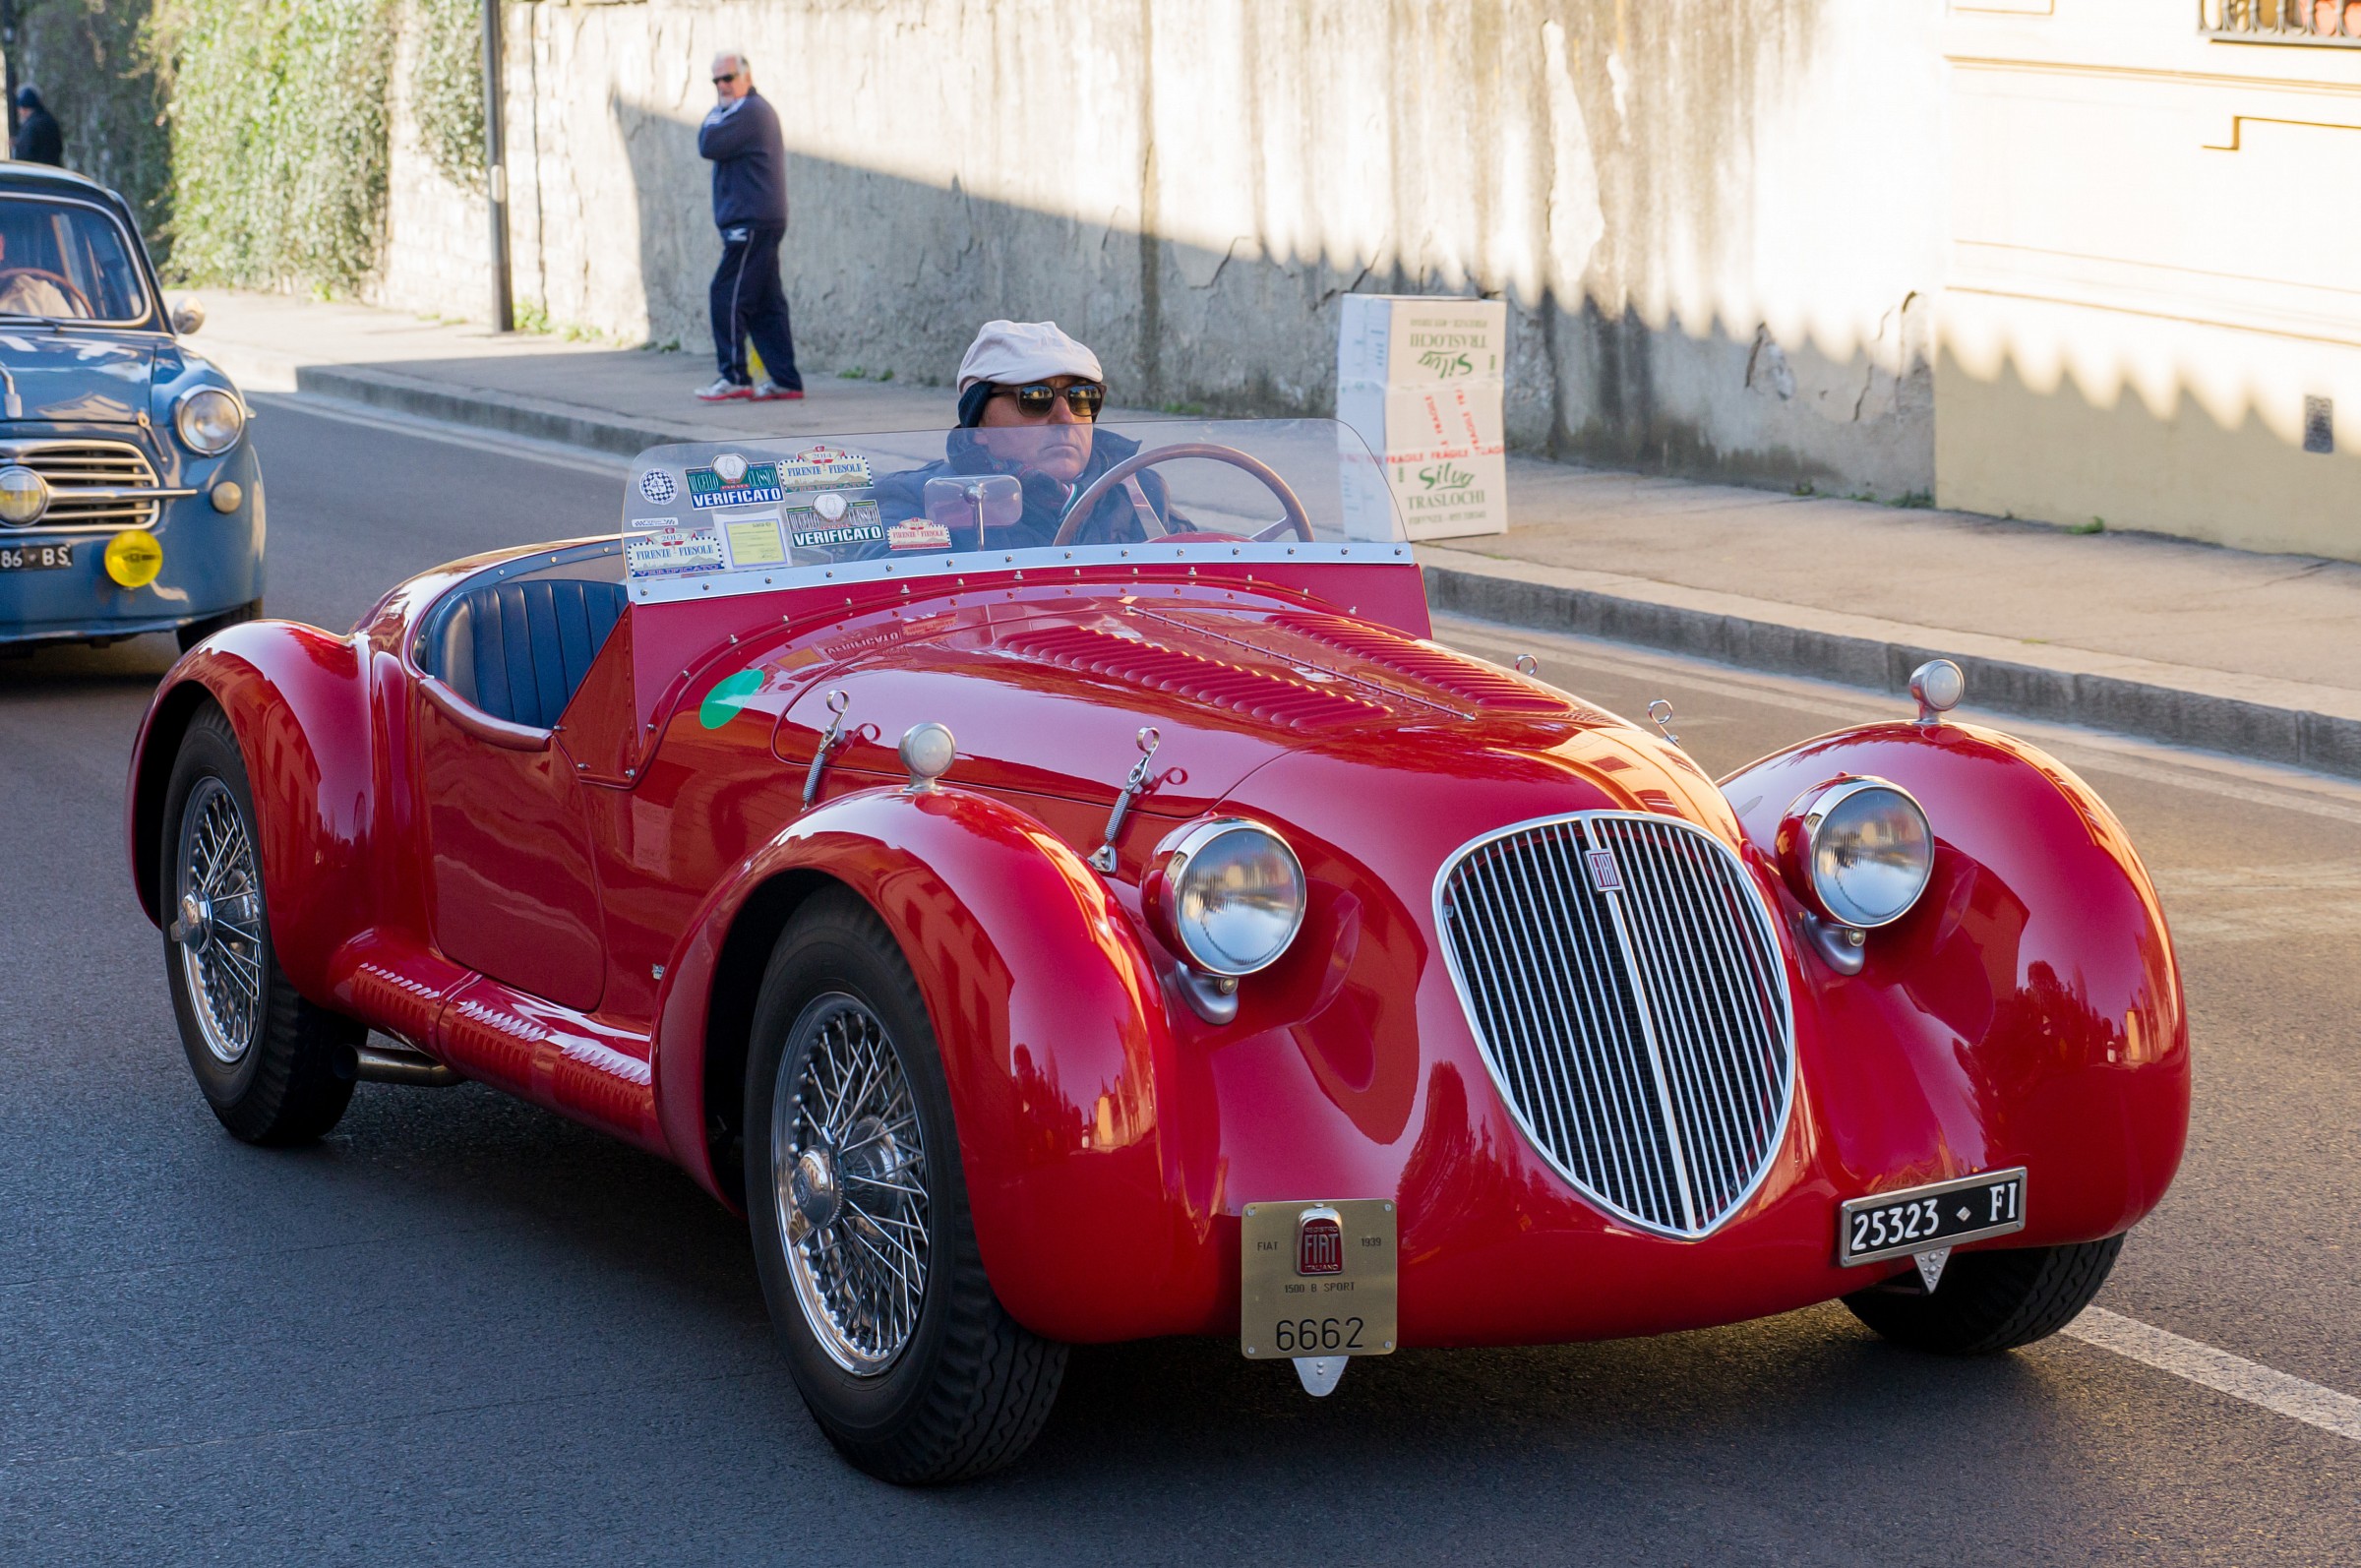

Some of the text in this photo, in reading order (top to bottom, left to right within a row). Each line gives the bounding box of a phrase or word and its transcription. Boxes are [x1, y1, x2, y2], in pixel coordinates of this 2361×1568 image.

[1410, 333, 1487, 349] TRASLOCHI
[1385, 452, 1423, 464] FRAGILE
[1431, 450, 1469, 461] FRAGILE
[787, 463, 863, 477] FIRENZE FIESOLE
[694, 488, 781, 508] VERIFICATO
[1407, 490, 1484, 510] TRASLOCHI
[794, 526, 881, 546] VERIFICATO
[636, 545, 713, 561] FIRENZE FIESOLE
[1591, 854, 1618, 886] FIAT
[1850, 1182, 2017, 1250] 25323 FI
[1257, 1241, 1278, 1251] FIAT
[1304, 1234, 1339, 1264] FIAT
[1362, 1237, 1382, 1247] 1939
[1285, 1282, 1355, 1294] 1500 B SPORT
[1276, 1317, 1363, 1352] 6662
